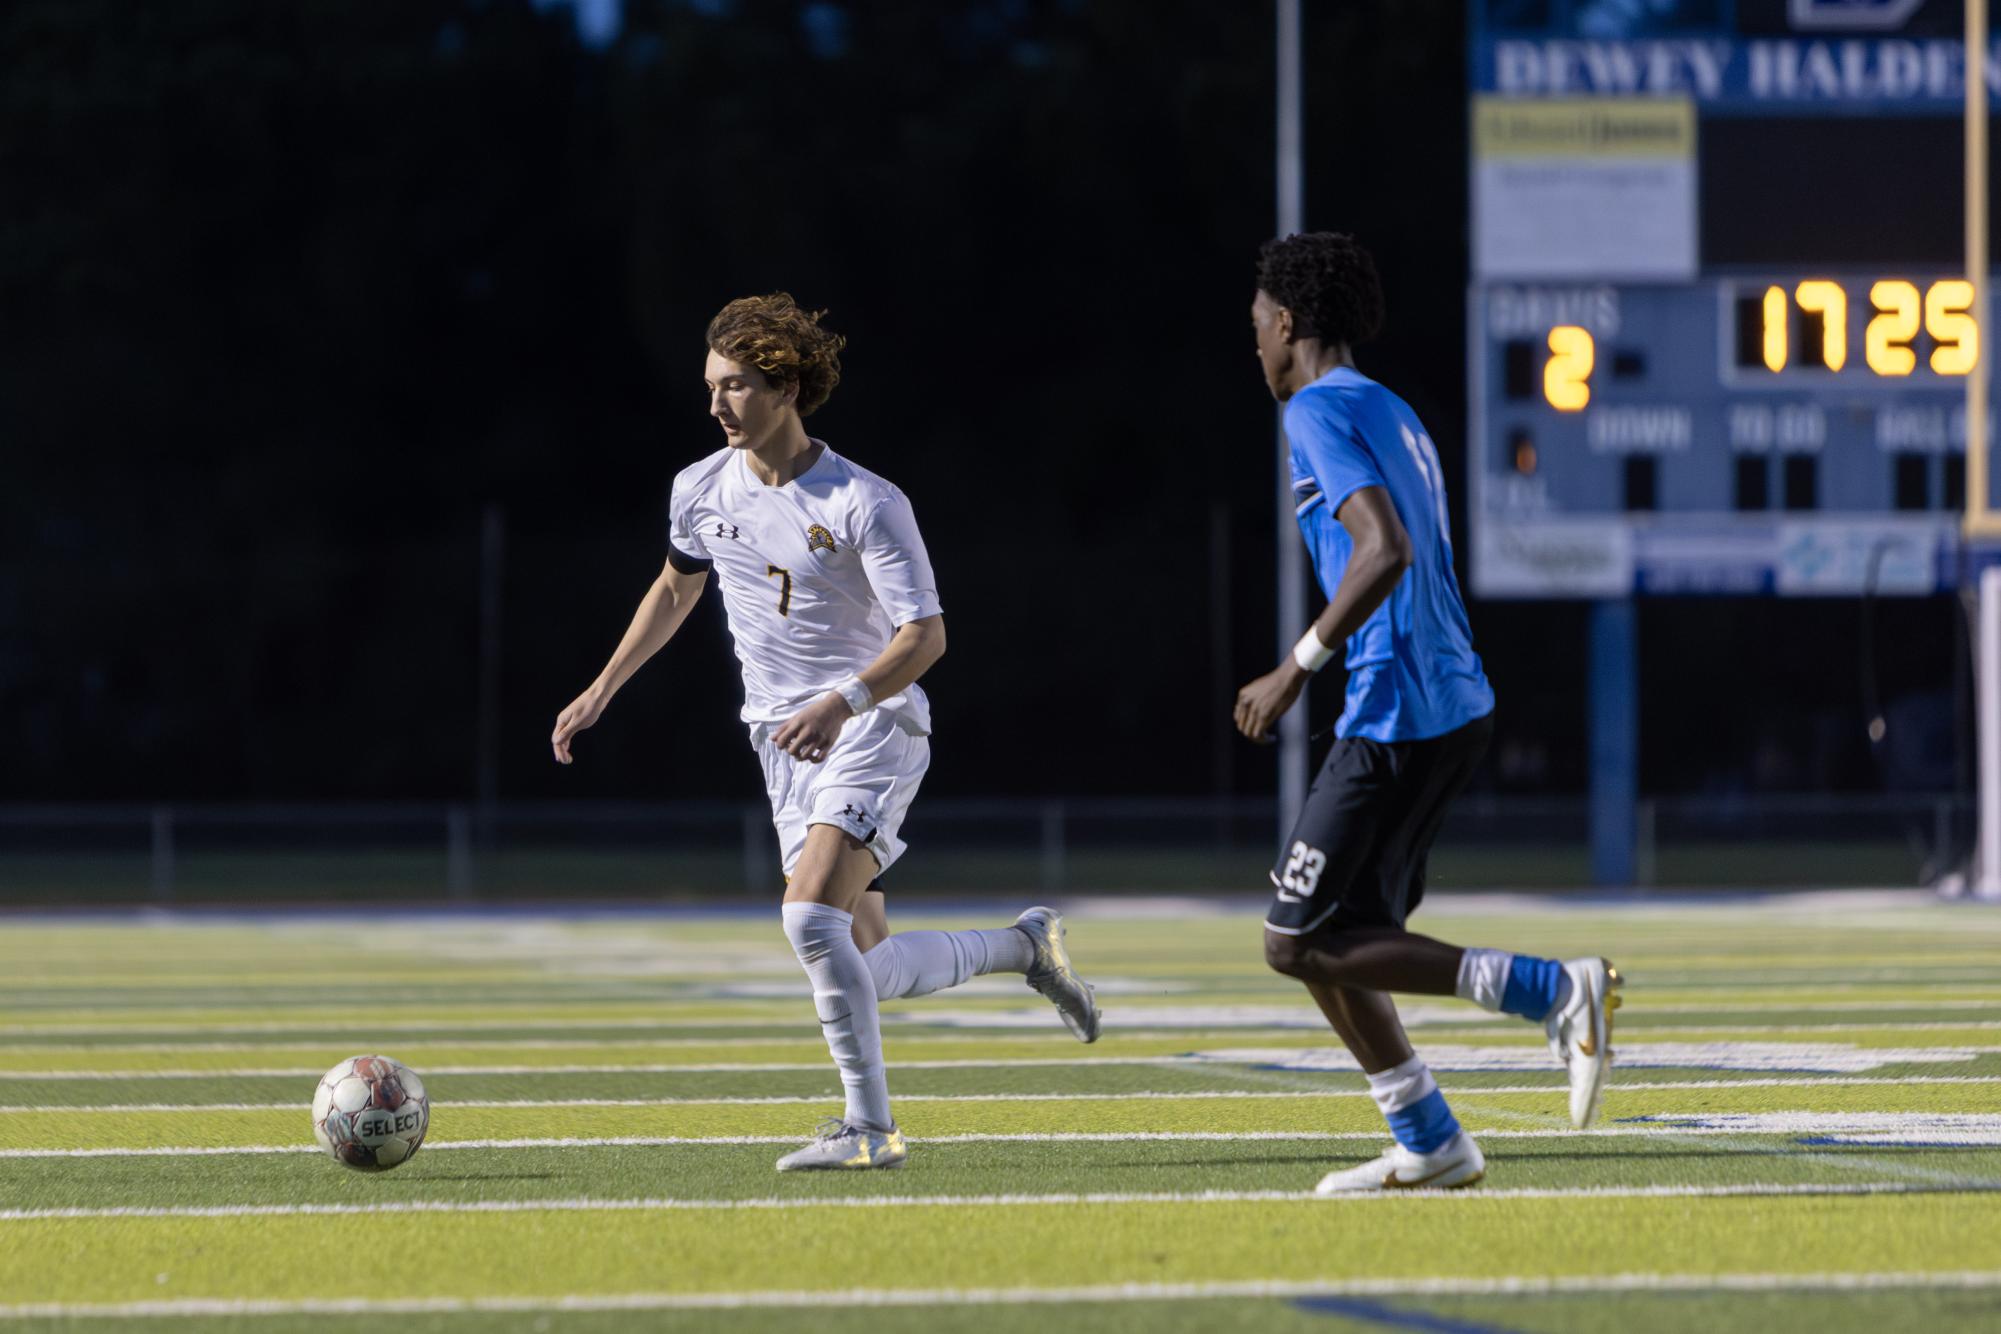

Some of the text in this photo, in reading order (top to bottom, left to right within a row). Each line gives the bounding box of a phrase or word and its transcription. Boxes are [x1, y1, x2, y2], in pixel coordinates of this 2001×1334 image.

[1495, 39, 1731, 97] DEWEY
[1763, 280, 1979, 376] 17 25
[1543, 324, 1594, 411] 2
[1587, 405, 1692, 452] DOWN
[767, 564, 792, 618] 7
[1282, 839, 1327, 898] 23
[361, 1111, 420, 1138] SELECT
